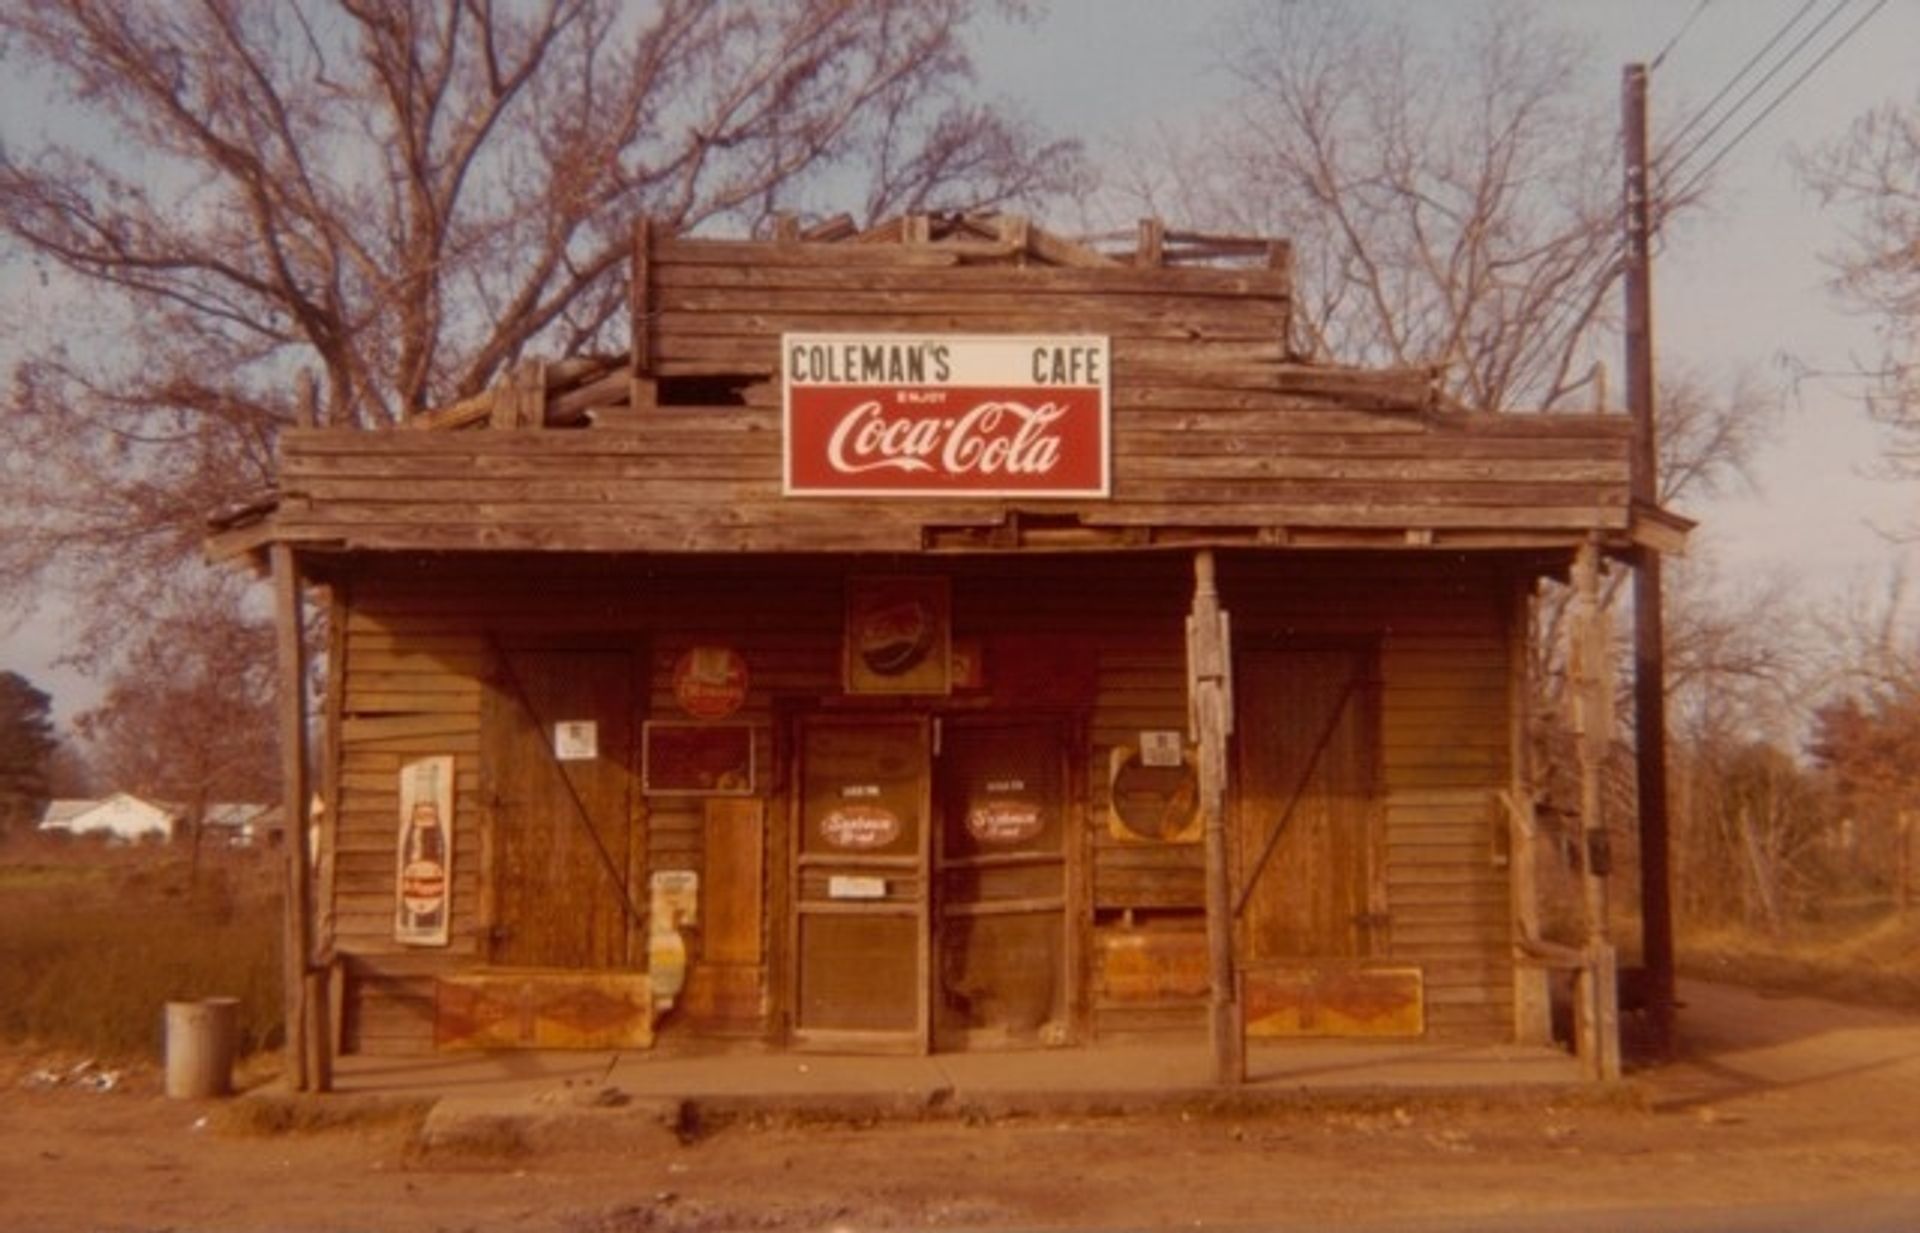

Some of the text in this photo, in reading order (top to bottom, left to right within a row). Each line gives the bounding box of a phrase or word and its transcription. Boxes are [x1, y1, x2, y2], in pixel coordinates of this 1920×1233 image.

[790, 343, 1100, 384] COLEMAN'S CAFE
[827, 401, 1070, 474] Coca-Cola
